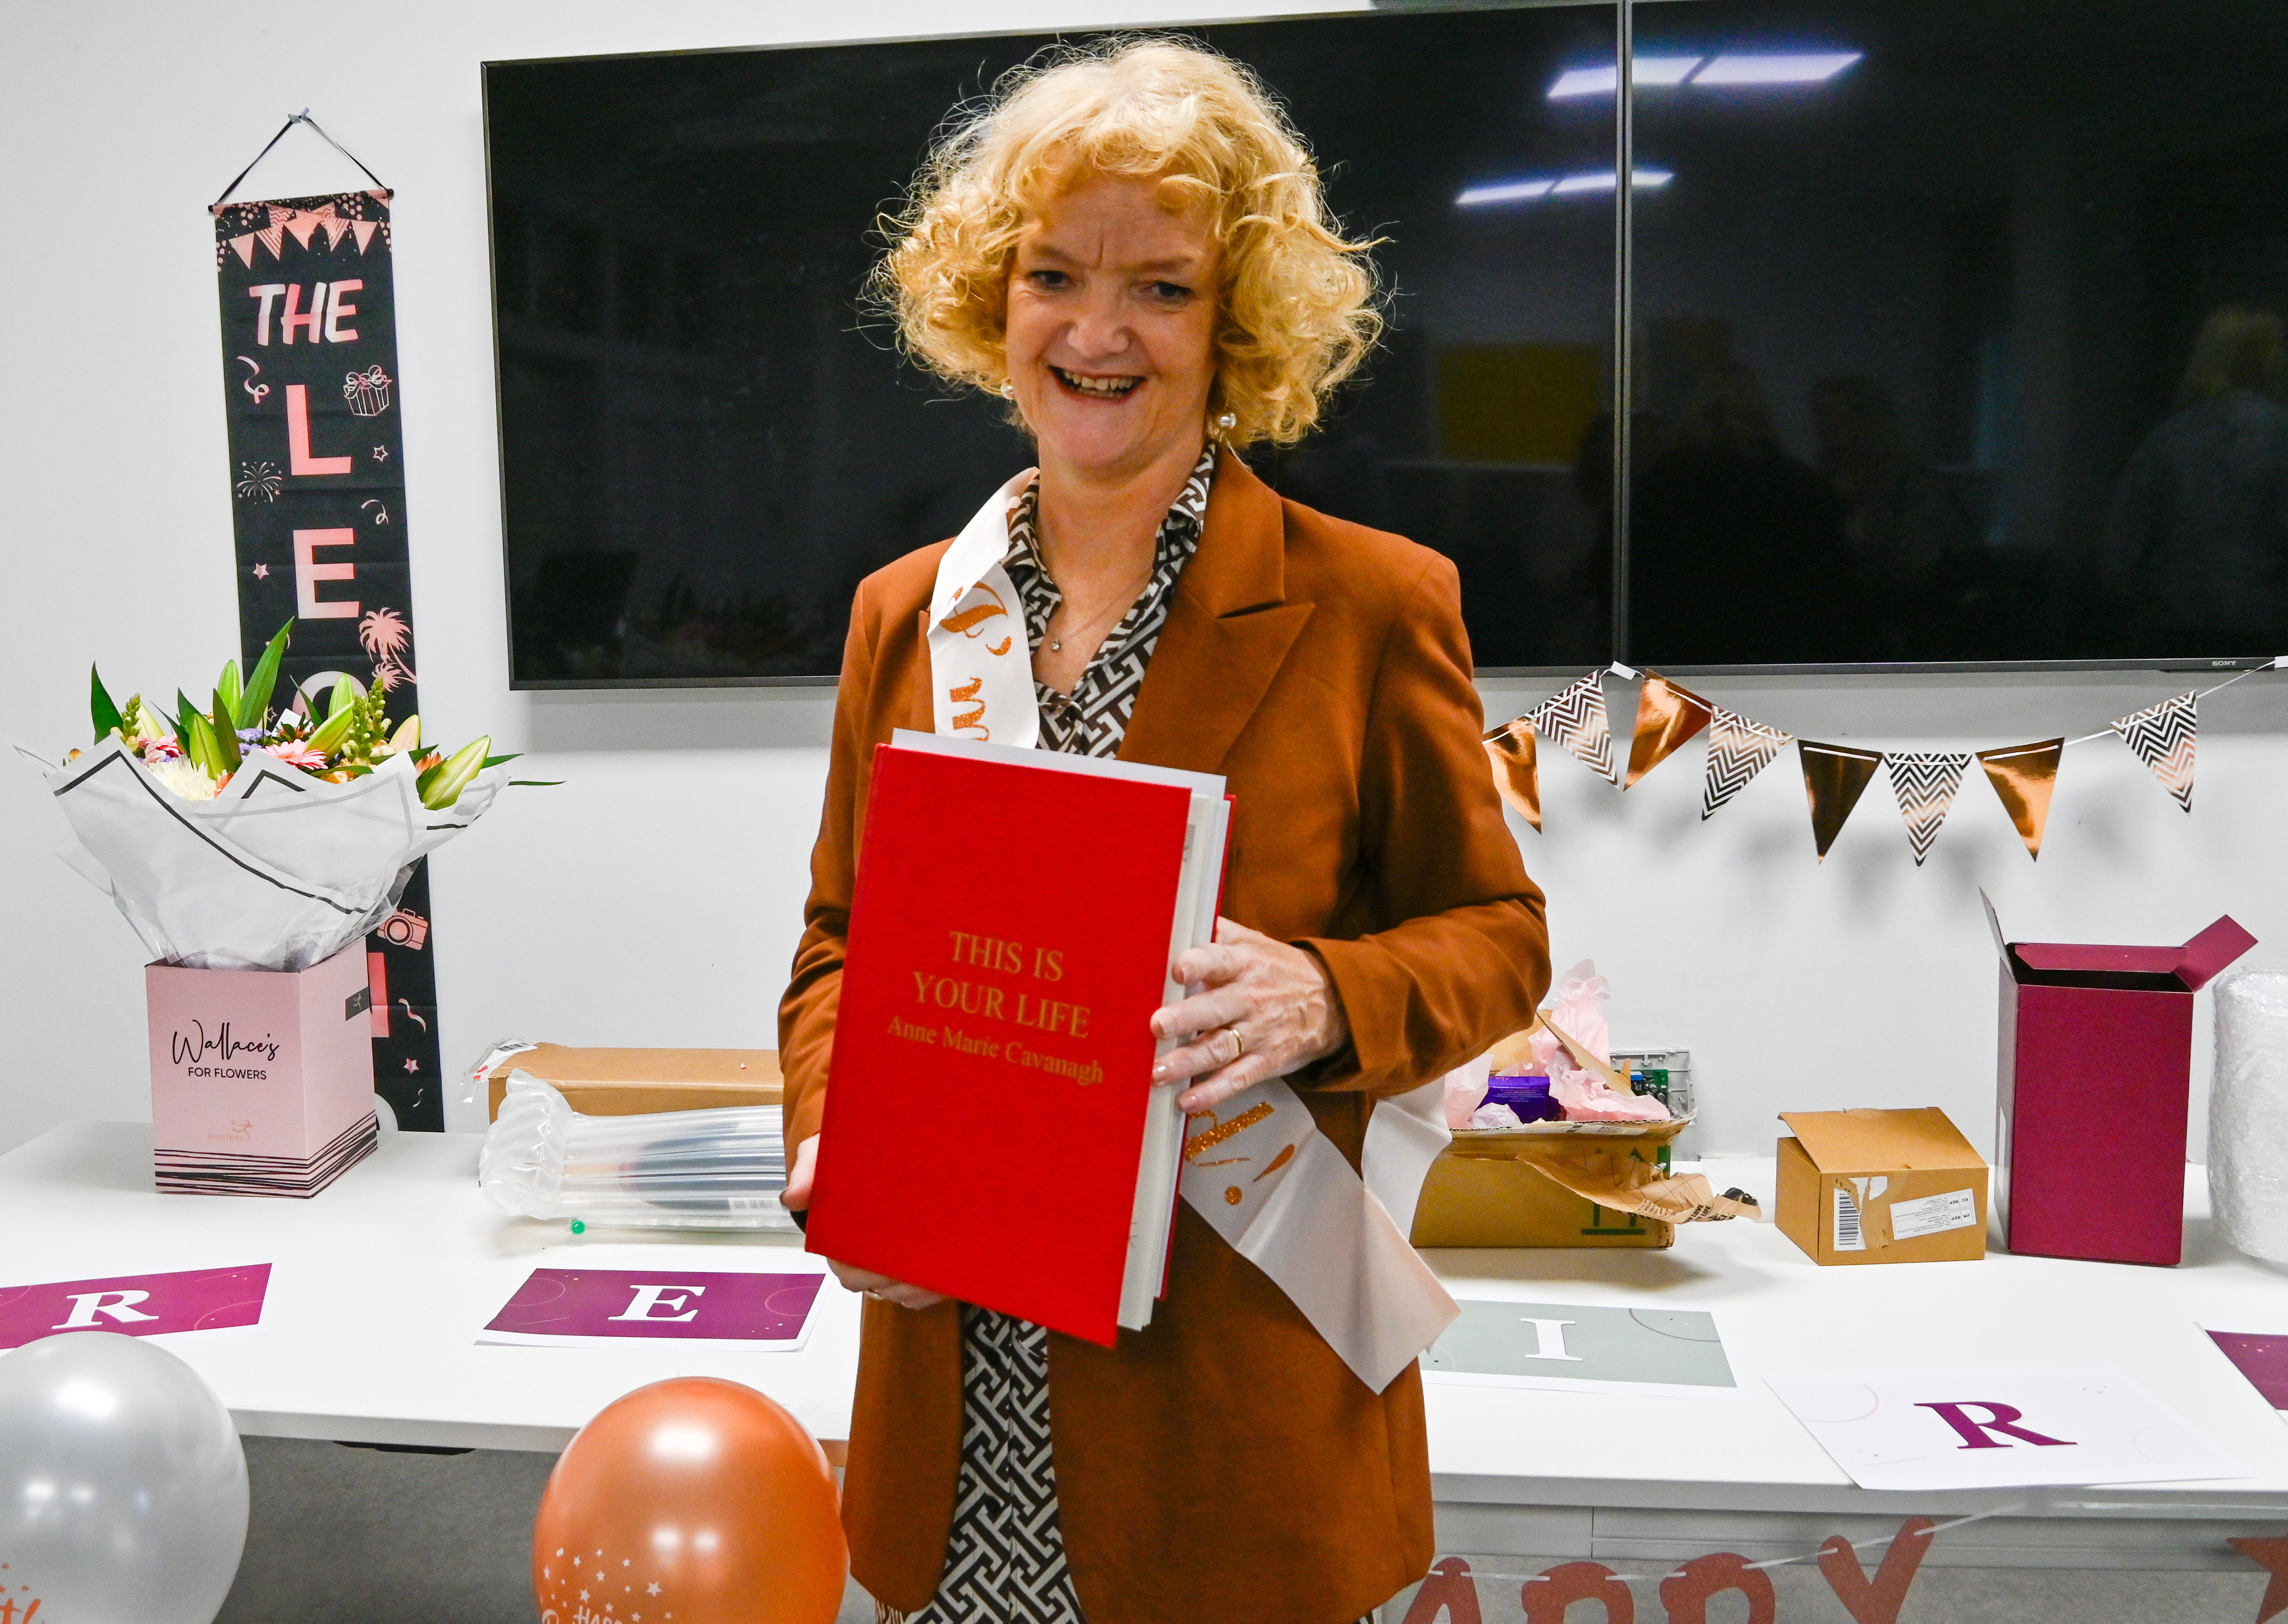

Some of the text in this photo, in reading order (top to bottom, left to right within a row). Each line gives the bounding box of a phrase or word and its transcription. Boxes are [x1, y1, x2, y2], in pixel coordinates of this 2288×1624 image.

[249, 279, 364, 346] THE
[950, 931, 1064, 982] THIS IS
[914, 971, 1091, 1038] YOUR LIFE
[172, 1019, 279, 1065] Wallace's
[887, 1015, 1105, 1086] Anne Marie Cavanagh
[188, 1067, 267, 1080] FOR FLOWERS
[1693, 1204, 1704, 1218] LOVE
[1700, 1205, 1712, 1217] LIFE
[52, 1289, 159, 1329] R
[608, 1285, 706, 1322] E
[1520, 1318, 1583, 1361] I
[1913, 1401, 2078, 1449] R
